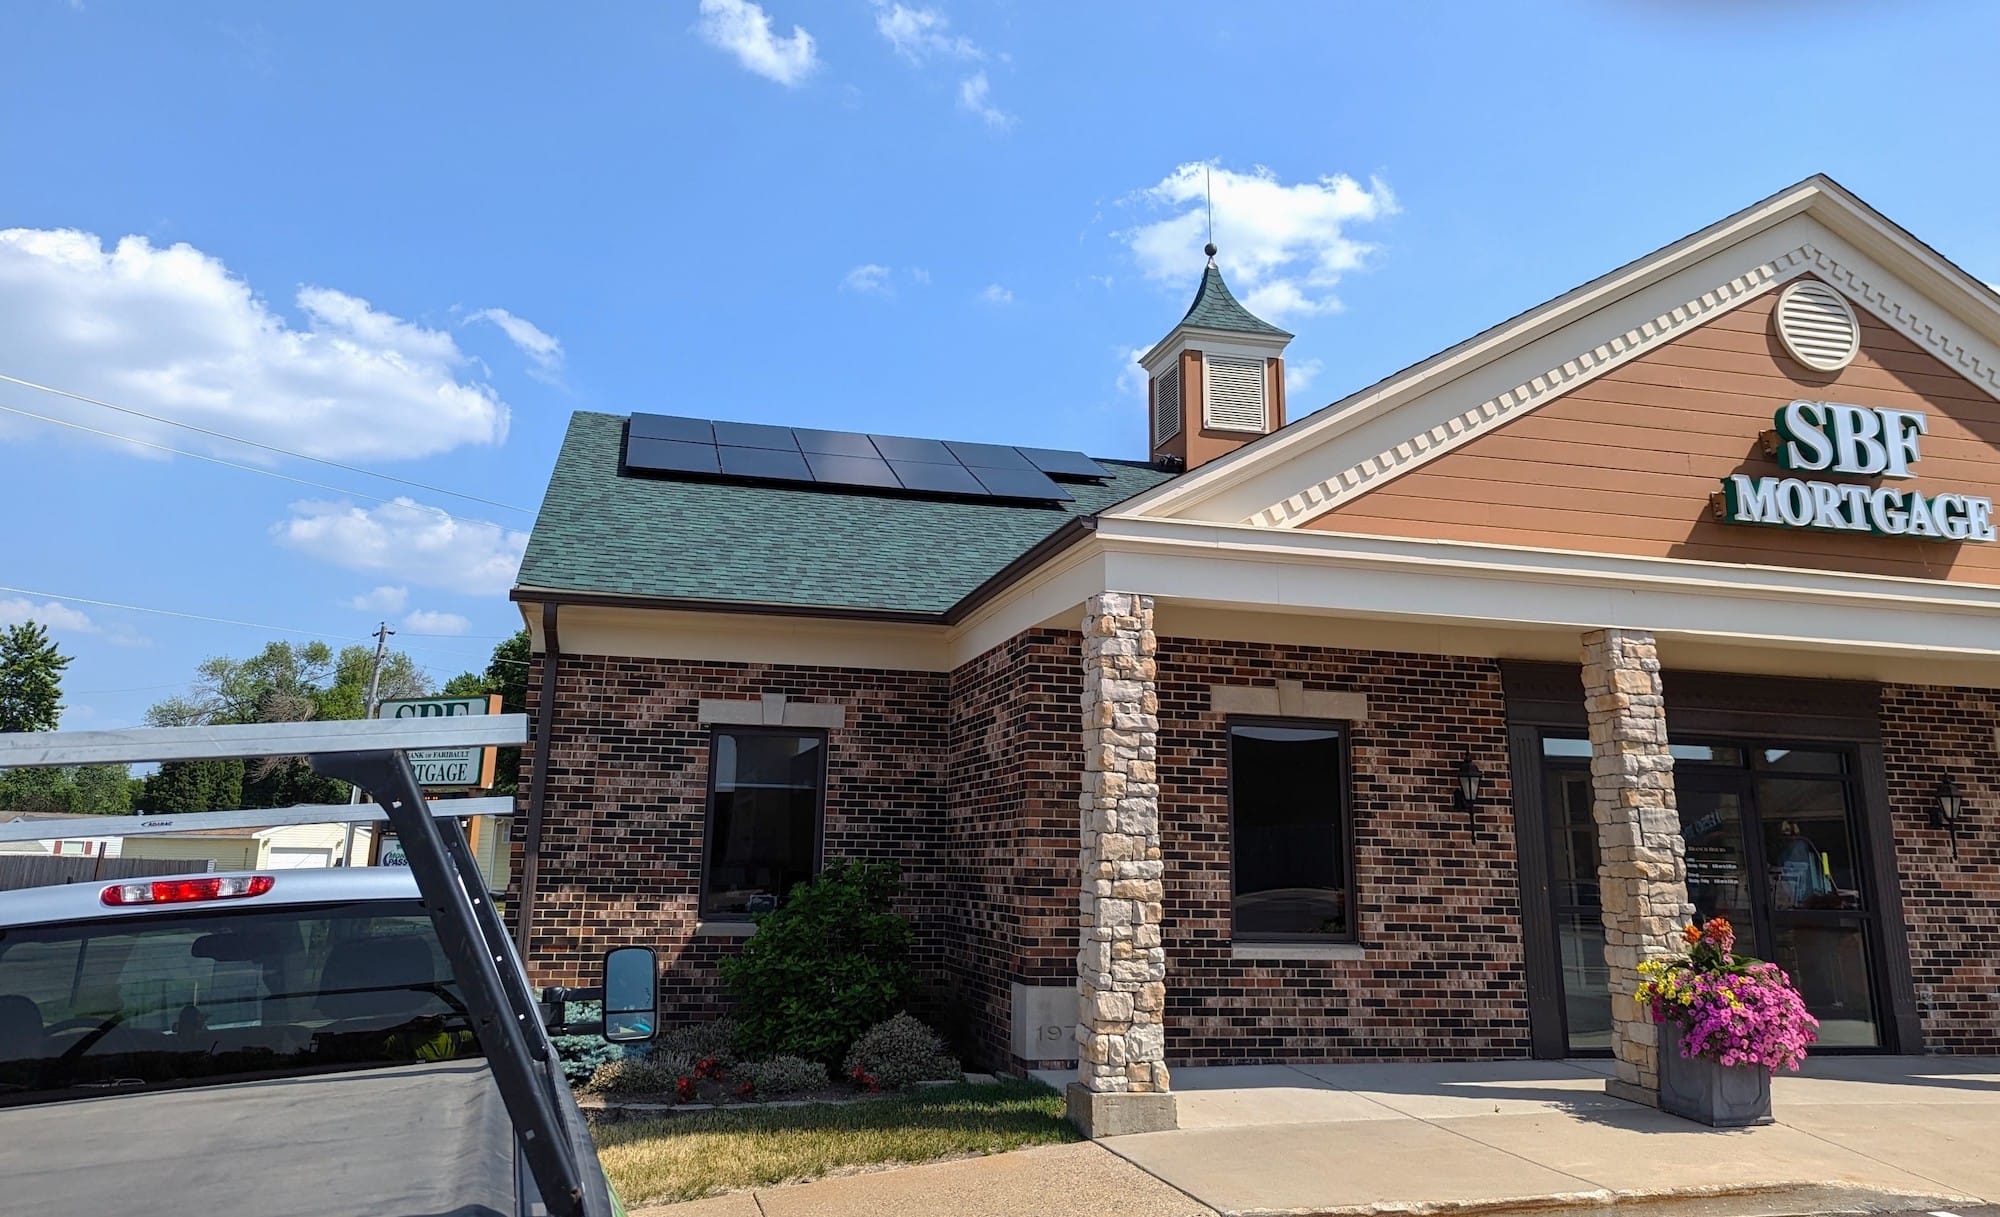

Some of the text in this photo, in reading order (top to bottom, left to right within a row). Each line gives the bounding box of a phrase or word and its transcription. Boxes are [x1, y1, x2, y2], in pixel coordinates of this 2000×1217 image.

[1784, 399, 1928, 478] SBF
[1731, 474, 1997, 541] MORTGAGE
[407, 751, 425, 759] ANK
[433, 750, 469, 759] FARIBAULT
[411, 763, 468, 782] TGAGE
[1037, 1025, 1077, 1042] 197
